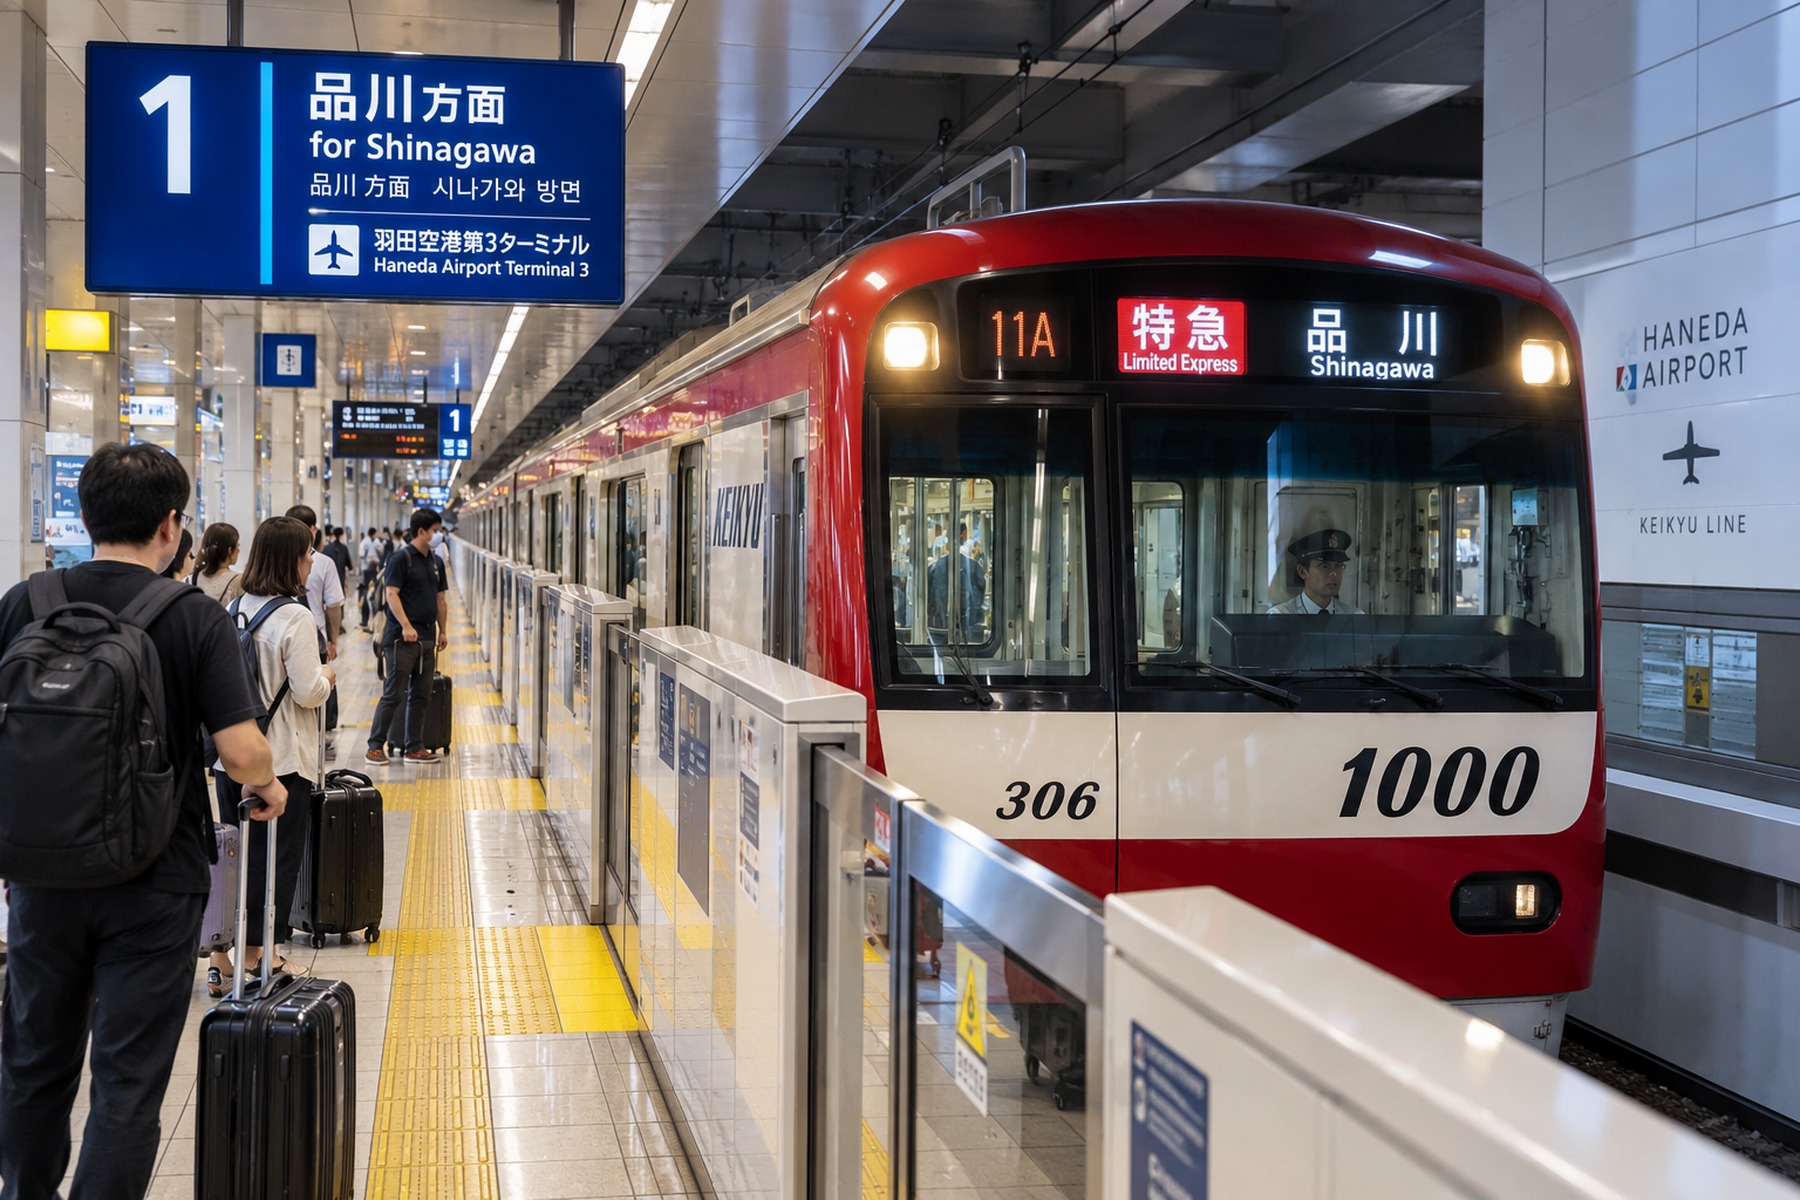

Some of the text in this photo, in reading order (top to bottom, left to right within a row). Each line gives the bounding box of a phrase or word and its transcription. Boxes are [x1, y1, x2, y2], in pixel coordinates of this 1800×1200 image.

[309, 71, 506, 125] 品川方面
[138, 74, 192, 195] 1
[309, 130, 536, 169] for Shinagawa
[432, 176, 581, 204] 시나가와 방면
[373, 228, 590, 256] 羽田空港第3ターミナル
[374, 257, 590, 278] Haneda Airport Terminal 3
[991, 310, 1056, 358] 11A
[1132, 303, 1229, 351] 特急
[1307, 308, 1438, 356] 品川
[1643, 307, 1748, 353] HANEDA
[1123, 352, 1238, 375] Limited Express
[1310, 355, 1436, 379] Shinagawa
[1642, 345, 1748, 389] AIRPORT
[449, 408, 461, 432] 1
[712, 482, 765, 549] KEIKYU
[1640, 514, 1747, 534] KEIKYU LINE
[995, 780, 1100, 821] 306
[1339, 745, 1541, 818] 1000
